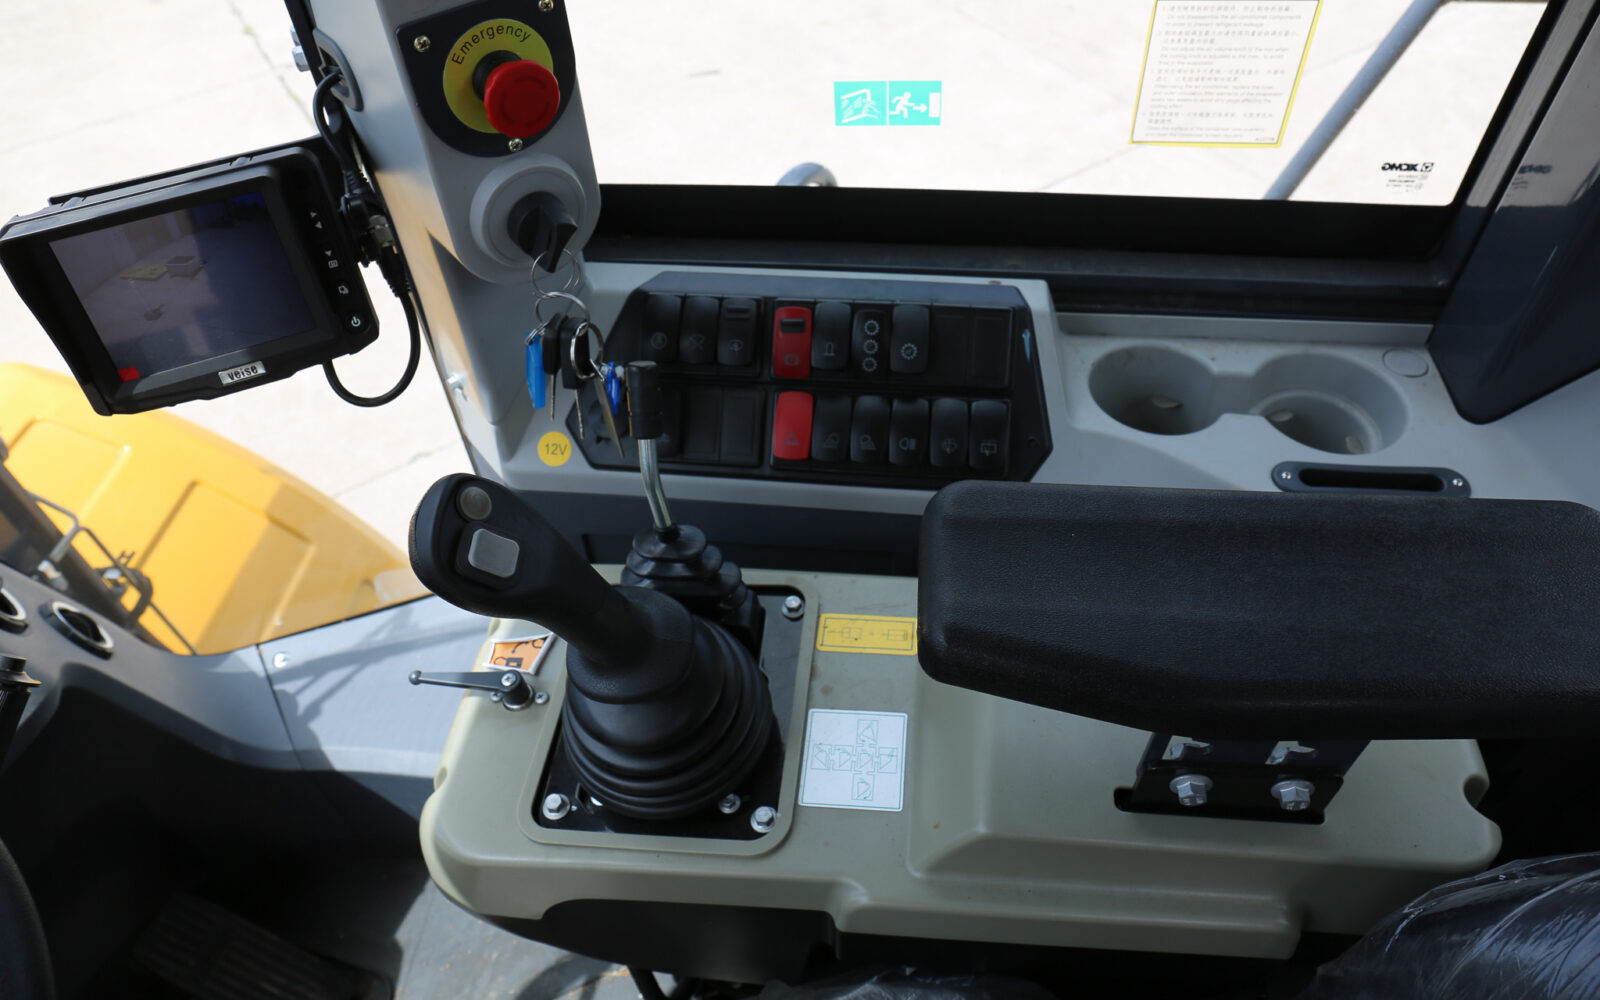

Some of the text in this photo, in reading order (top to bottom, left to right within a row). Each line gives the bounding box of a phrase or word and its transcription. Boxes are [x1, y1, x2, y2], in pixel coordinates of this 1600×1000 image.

[451, 24, 531, 65] Emergency
[227, 365, 258, 381] veise
[545, 442, 568, 456] 12V
